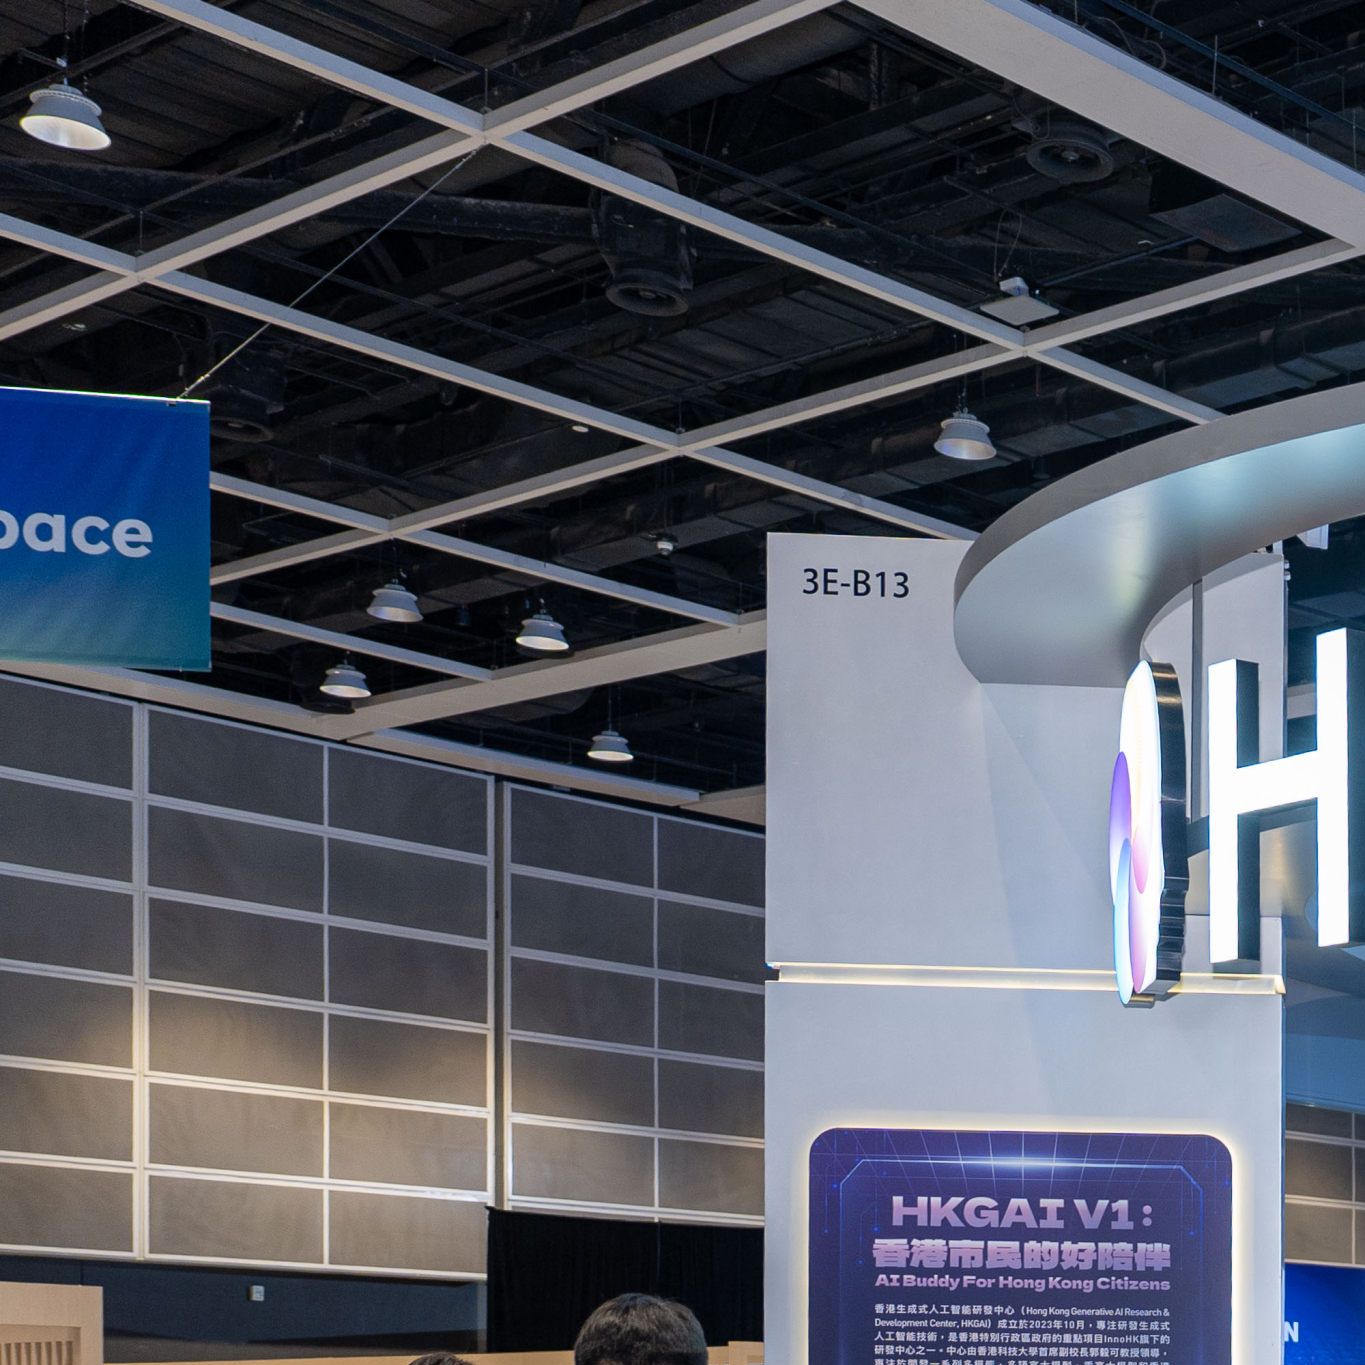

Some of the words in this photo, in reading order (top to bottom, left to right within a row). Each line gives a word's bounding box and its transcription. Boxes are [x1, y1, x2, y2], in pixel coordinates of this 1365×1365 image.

[802, 567, 909, 598] 3E-B13
[892, 1196, 1065, 1229] HKGAI
[872, 1238, 1171, 1271] 香港市民的好陪伴
[874, 1274, 901, 1287] AI
[902, 1274, 960, 1291] Buddy
[963, 1275, 995, 1289] For
[998, 1275, 1046, 1292] Hong
[1048, 1276, 1094, 1293] Kong
[1096, 1276, 1171, 1291] Citizens
